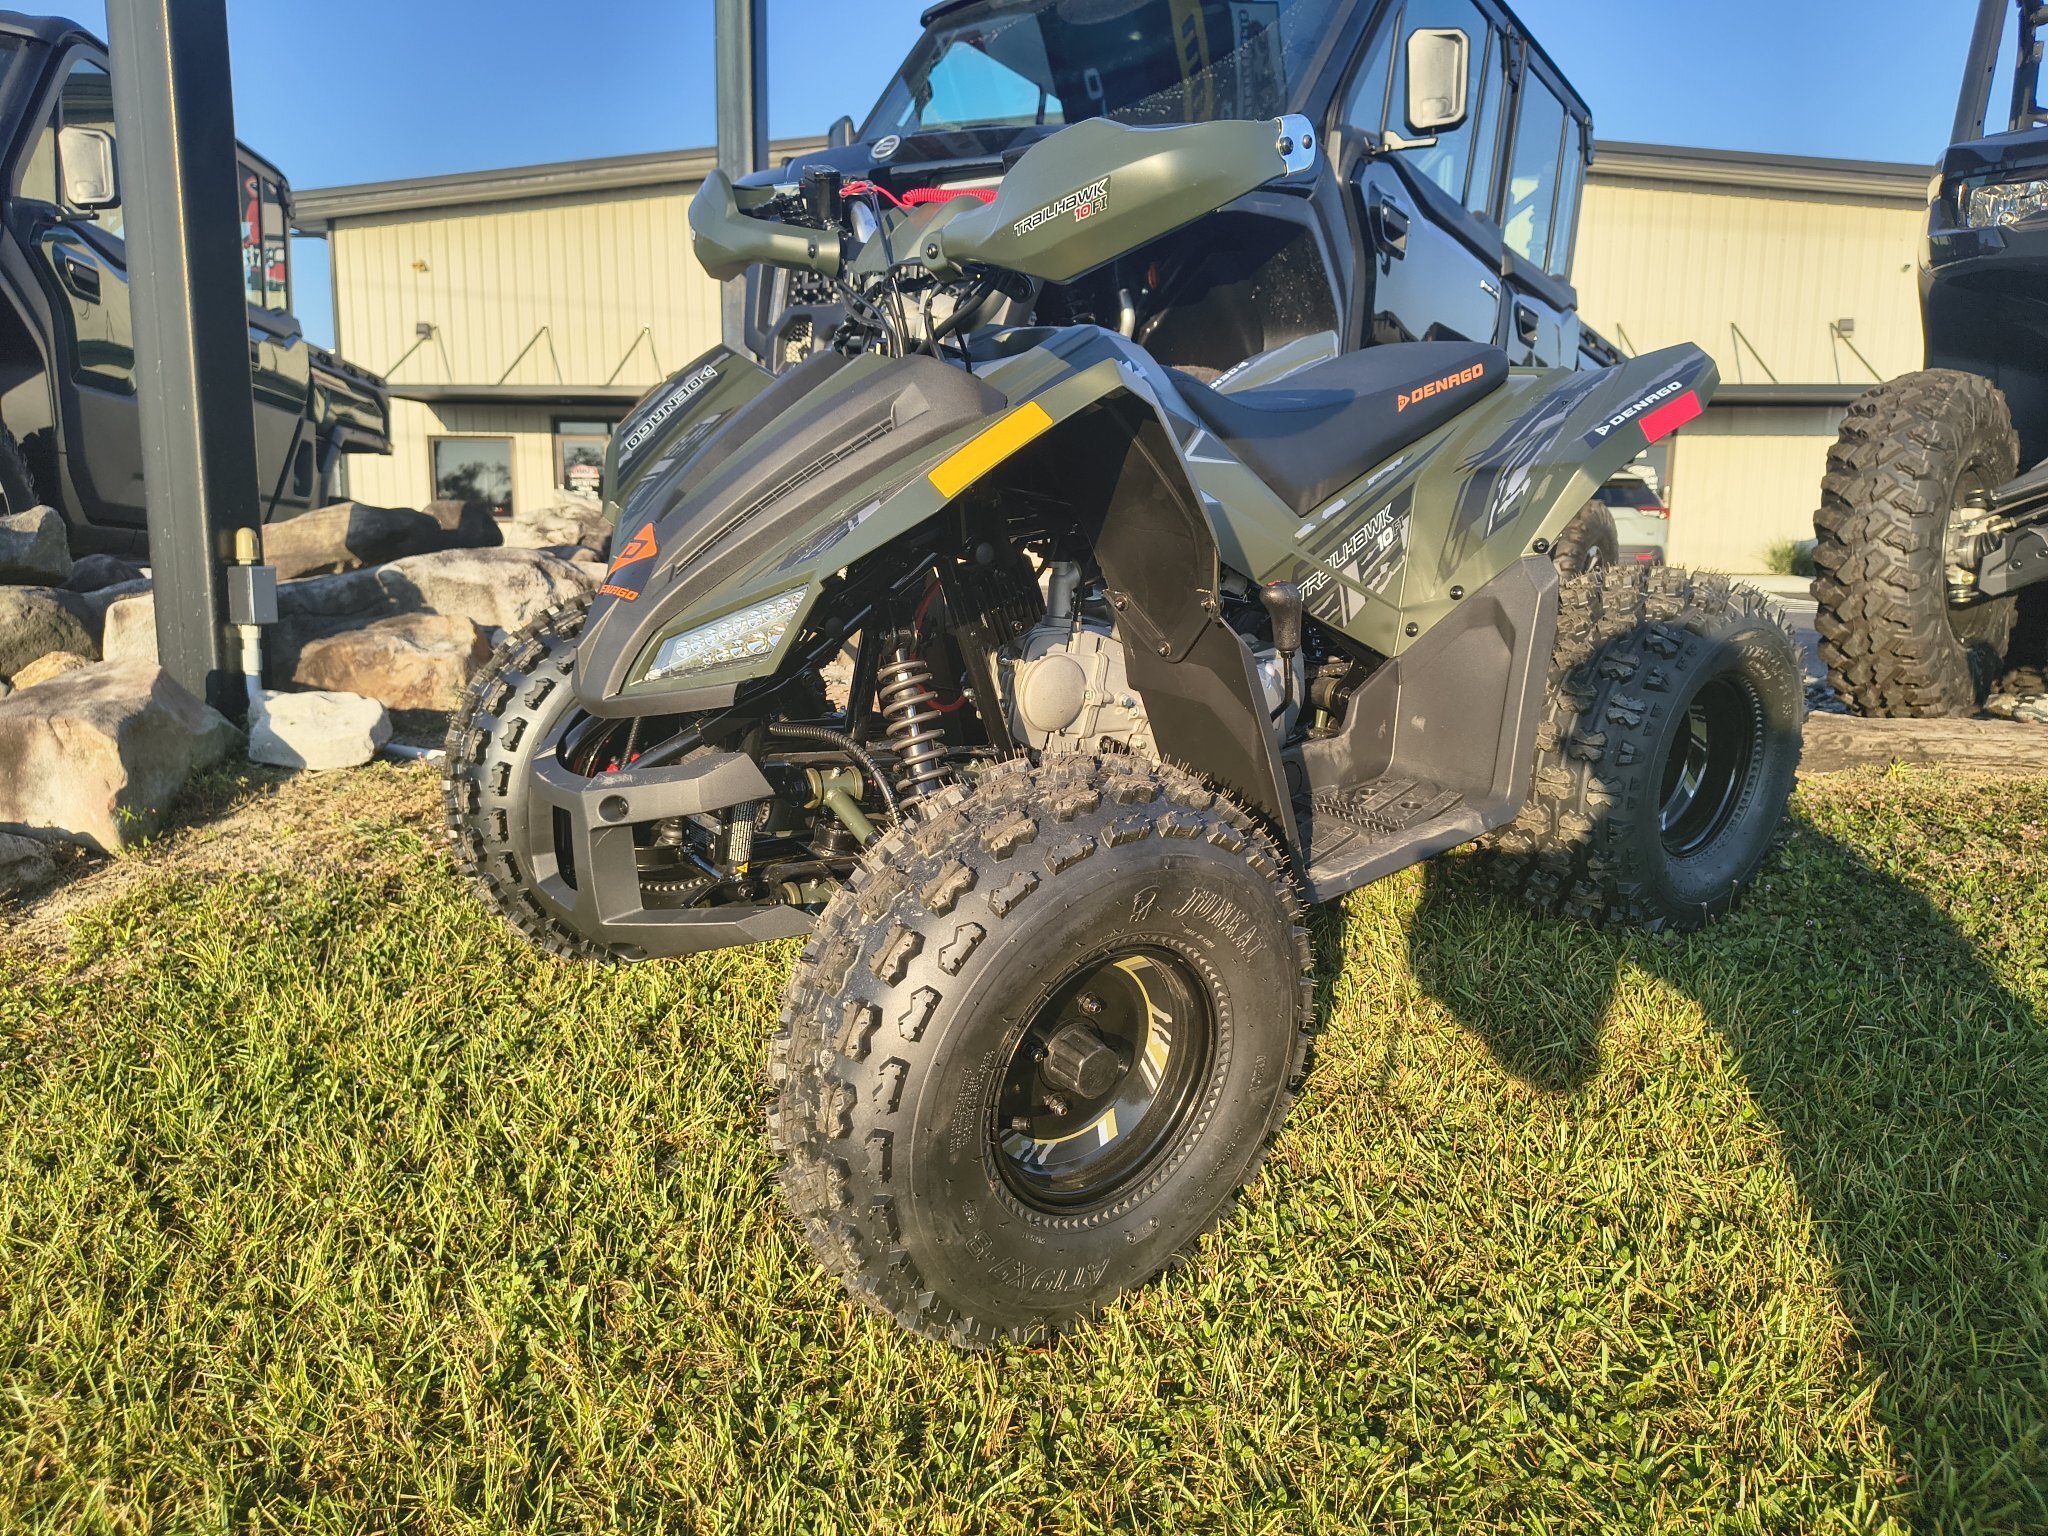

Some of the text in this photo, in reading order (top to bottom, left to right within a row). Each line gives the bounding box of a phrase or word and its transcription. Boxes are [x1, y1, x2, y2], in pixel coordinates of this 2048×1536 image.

[1411, 363, 1484, 404] DENAGO
[1609, 381, 1683, 426] DENAGO
[625, 376, 704, 451] DENAGO
[598, 584, 639, 601] ENAGO
